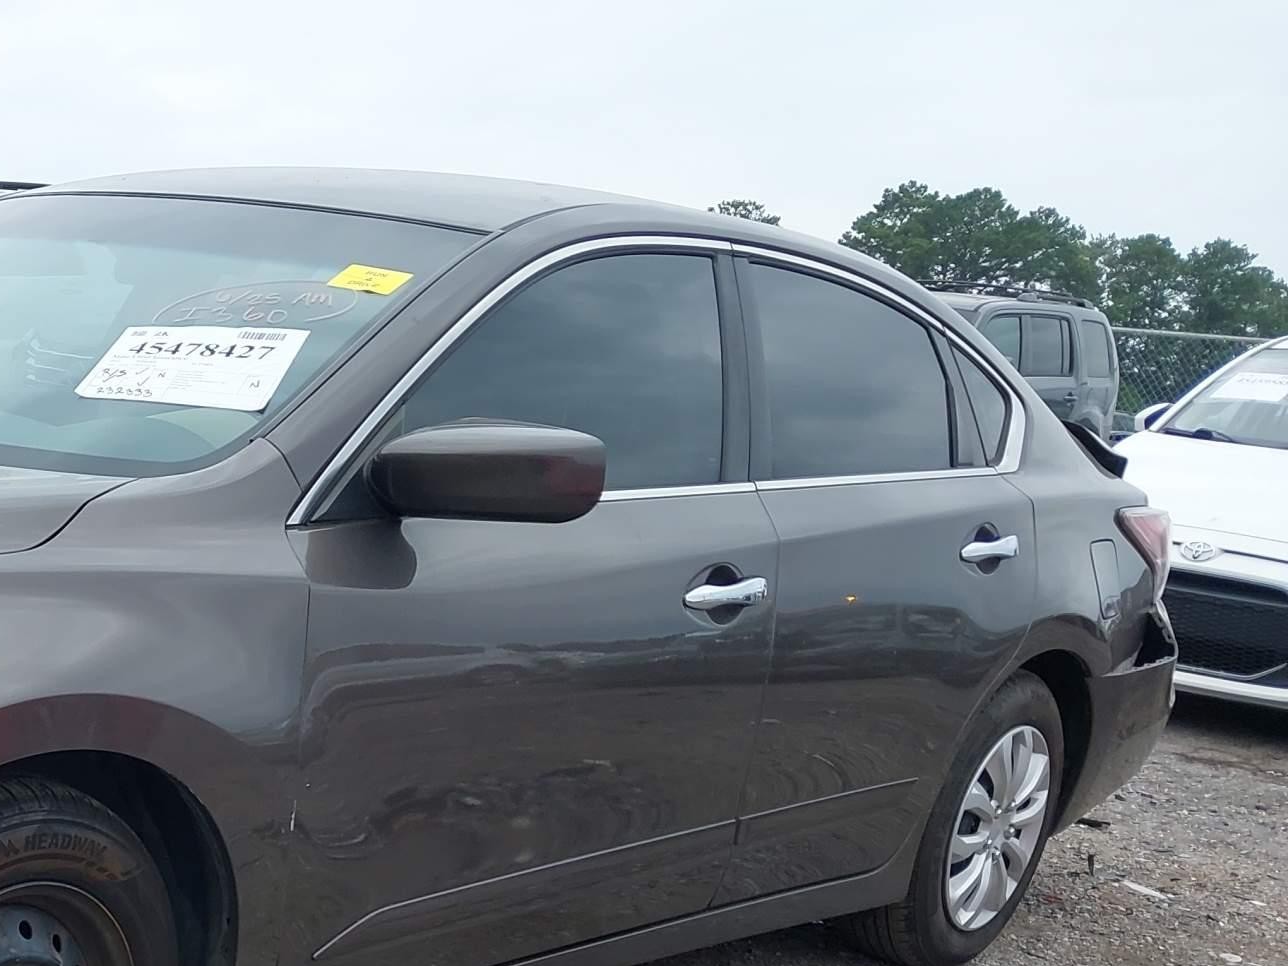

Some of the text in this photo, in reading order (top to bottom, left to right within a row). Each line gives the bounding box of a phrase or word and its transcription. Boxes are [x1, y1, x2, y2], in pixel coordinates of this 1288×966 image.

[216, 290, 332, 307] 6/25 AM
[128, 342, 276, 360] 45478427
[23, 832, 108, 857] HEADWAY
